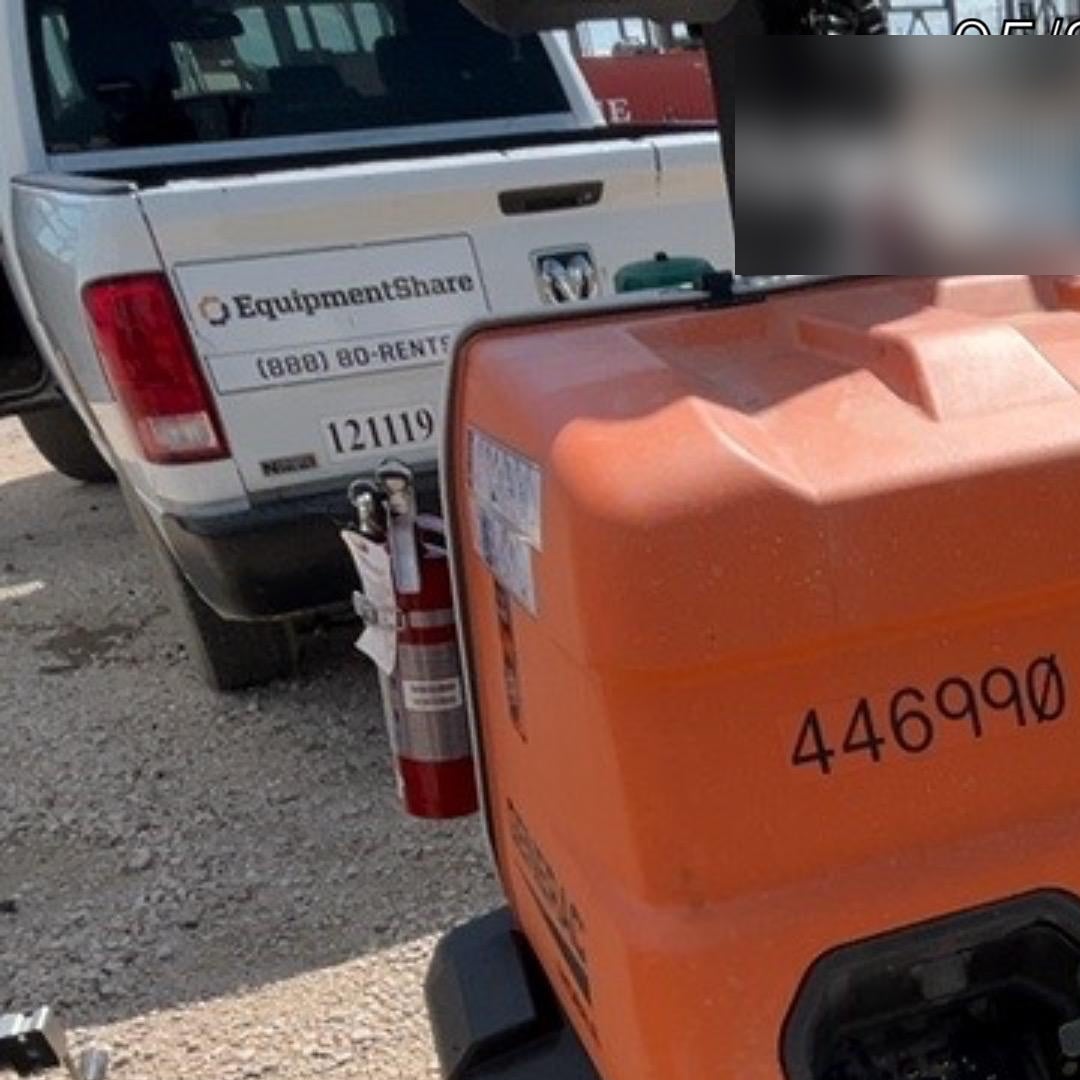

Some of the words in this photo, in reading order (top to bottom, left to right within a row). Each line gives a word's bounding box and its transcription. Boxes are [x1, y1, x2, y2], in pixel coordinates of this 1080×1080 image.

[233, 275, 475, 319] EquipmentShare
[256, 351, 329, 380] (888)
[328, 408, 434, 454] 121119
[791, 653, 1066, 775] 446990
